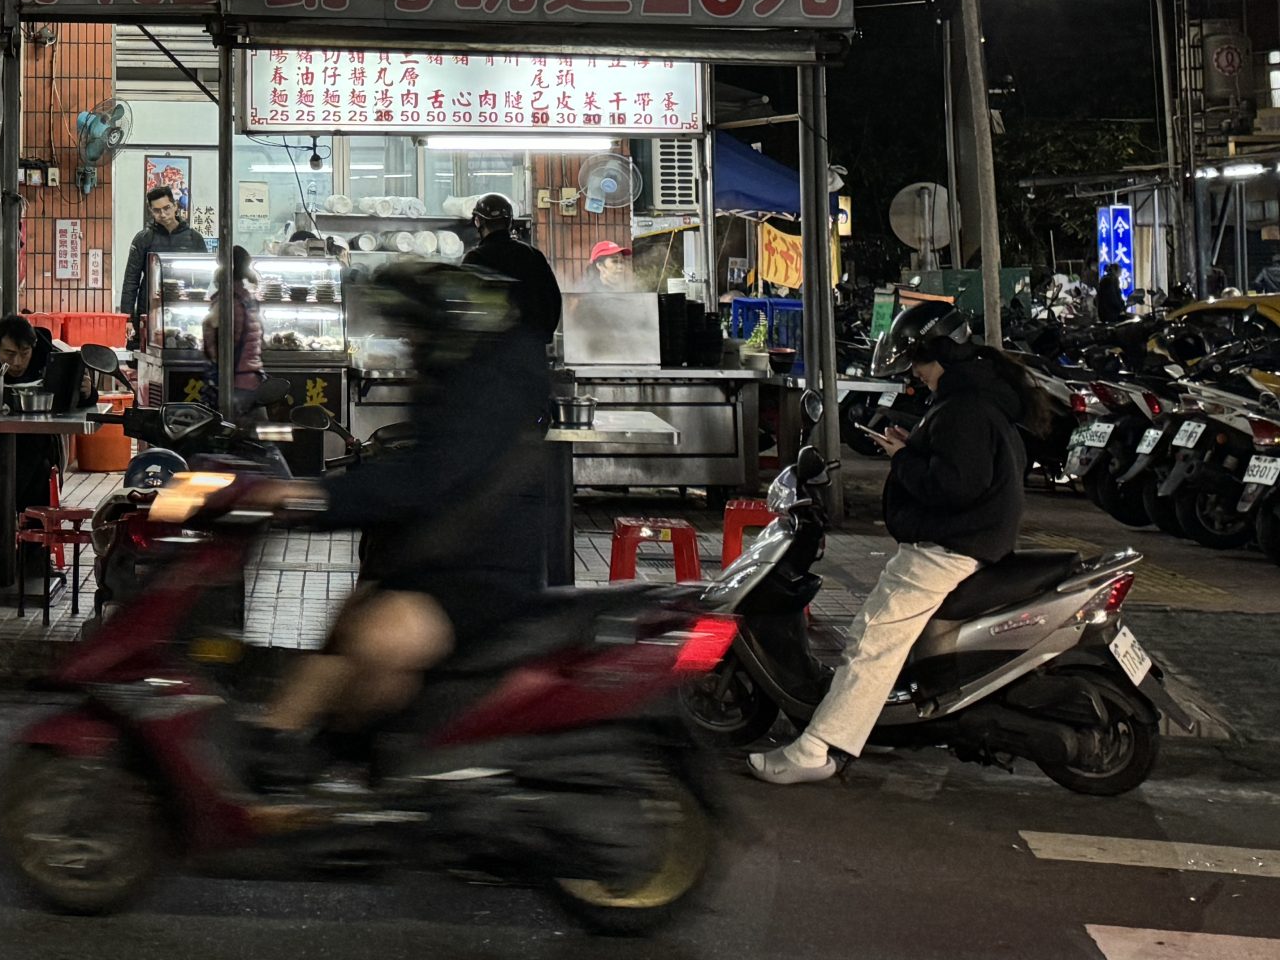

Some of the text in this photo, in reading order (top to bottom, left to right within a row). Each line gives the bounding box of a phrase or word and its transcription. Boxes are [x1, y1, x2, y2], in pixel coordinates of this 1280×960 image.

[270, 110, 289, 121] 25
[296, 110, 315, 121] 25
[322, 110, 341, 122] 25
[348, 110, 367, 122] 25
[400, 111, 420, 122] 50
[426, 111, 446, 122] 50
[452, 111, 472, 122] 50
[478, 112, 498, 122] 50
[504, 112, 524, 123] 50
[556, 113, 577, 123] 30
[633, 114, 653, 124] 20
[661, 114, 679, 125] 10
